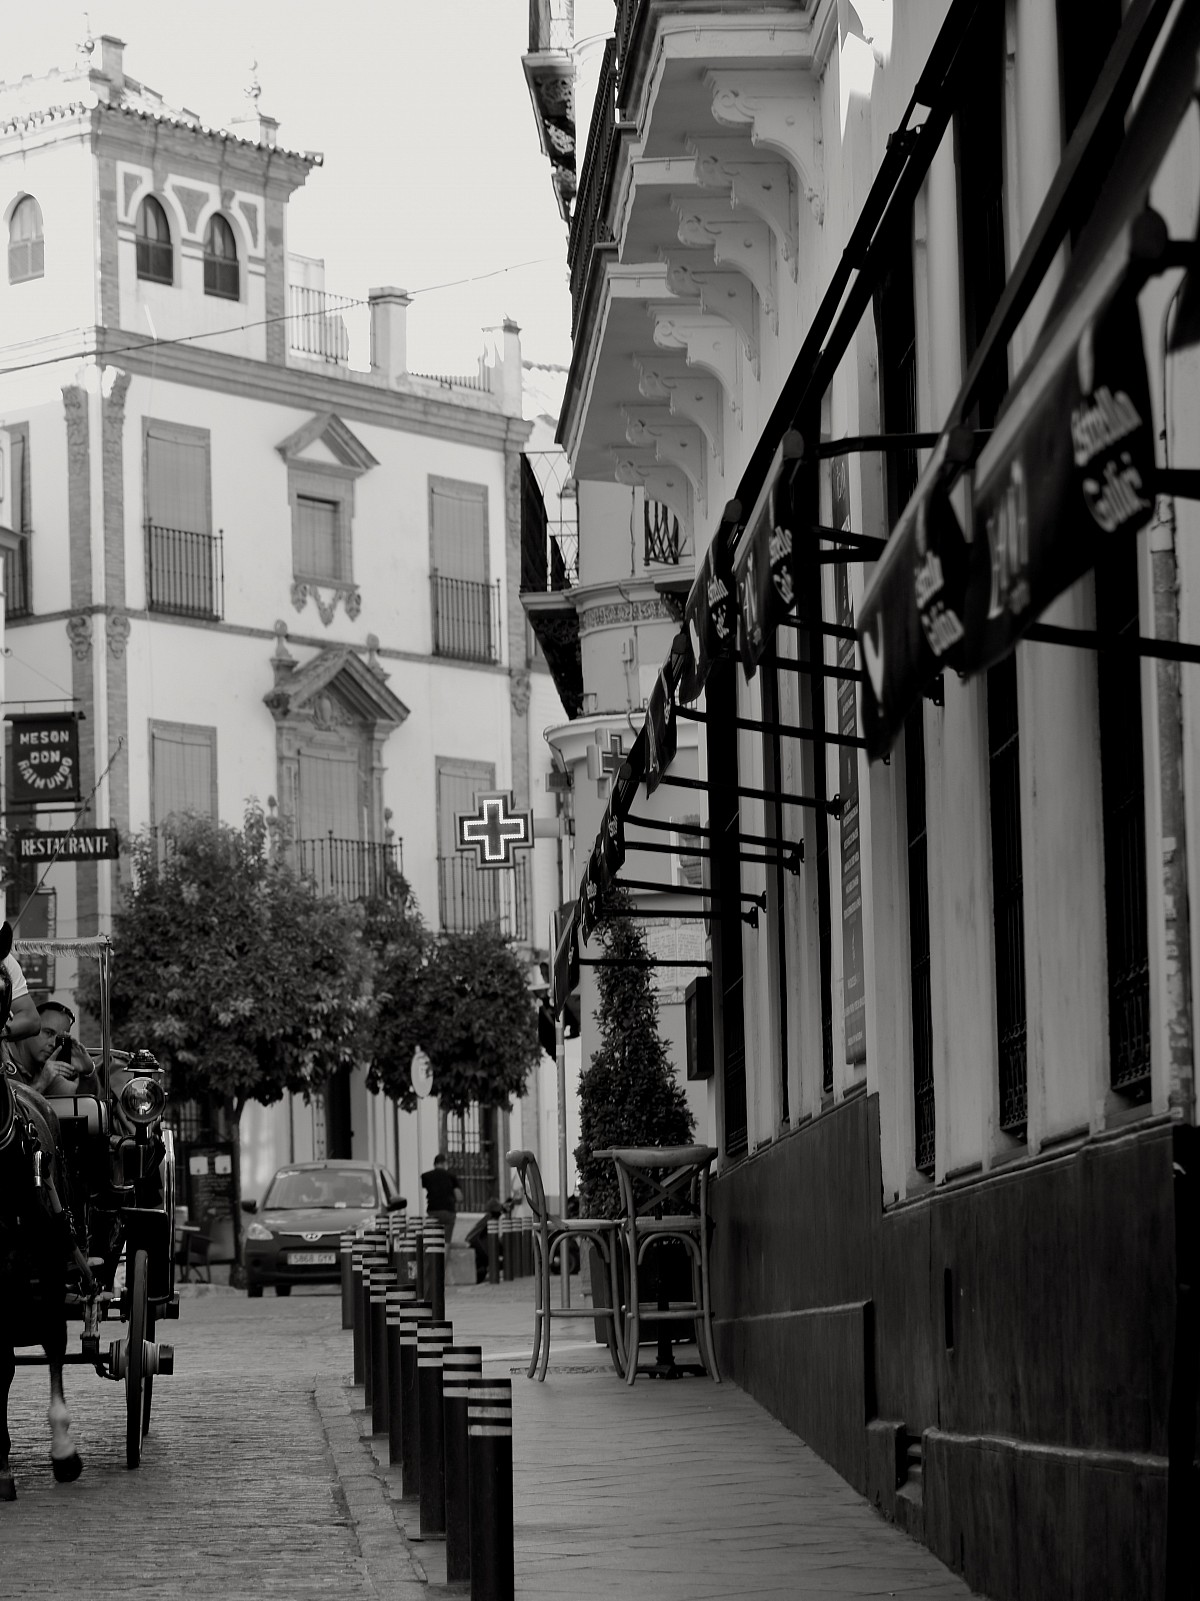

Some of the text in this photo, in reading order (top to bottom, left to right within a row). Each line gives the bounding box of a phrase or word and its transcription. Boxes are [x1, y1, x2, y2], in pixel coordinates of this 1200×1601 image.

[19, 730, 70, 745] MESON
[30, 750, 61, 765] DON
[17, 756, 73, 790] RAIMUNDO
[21, 835, 109, 857] RESTAURANTE
